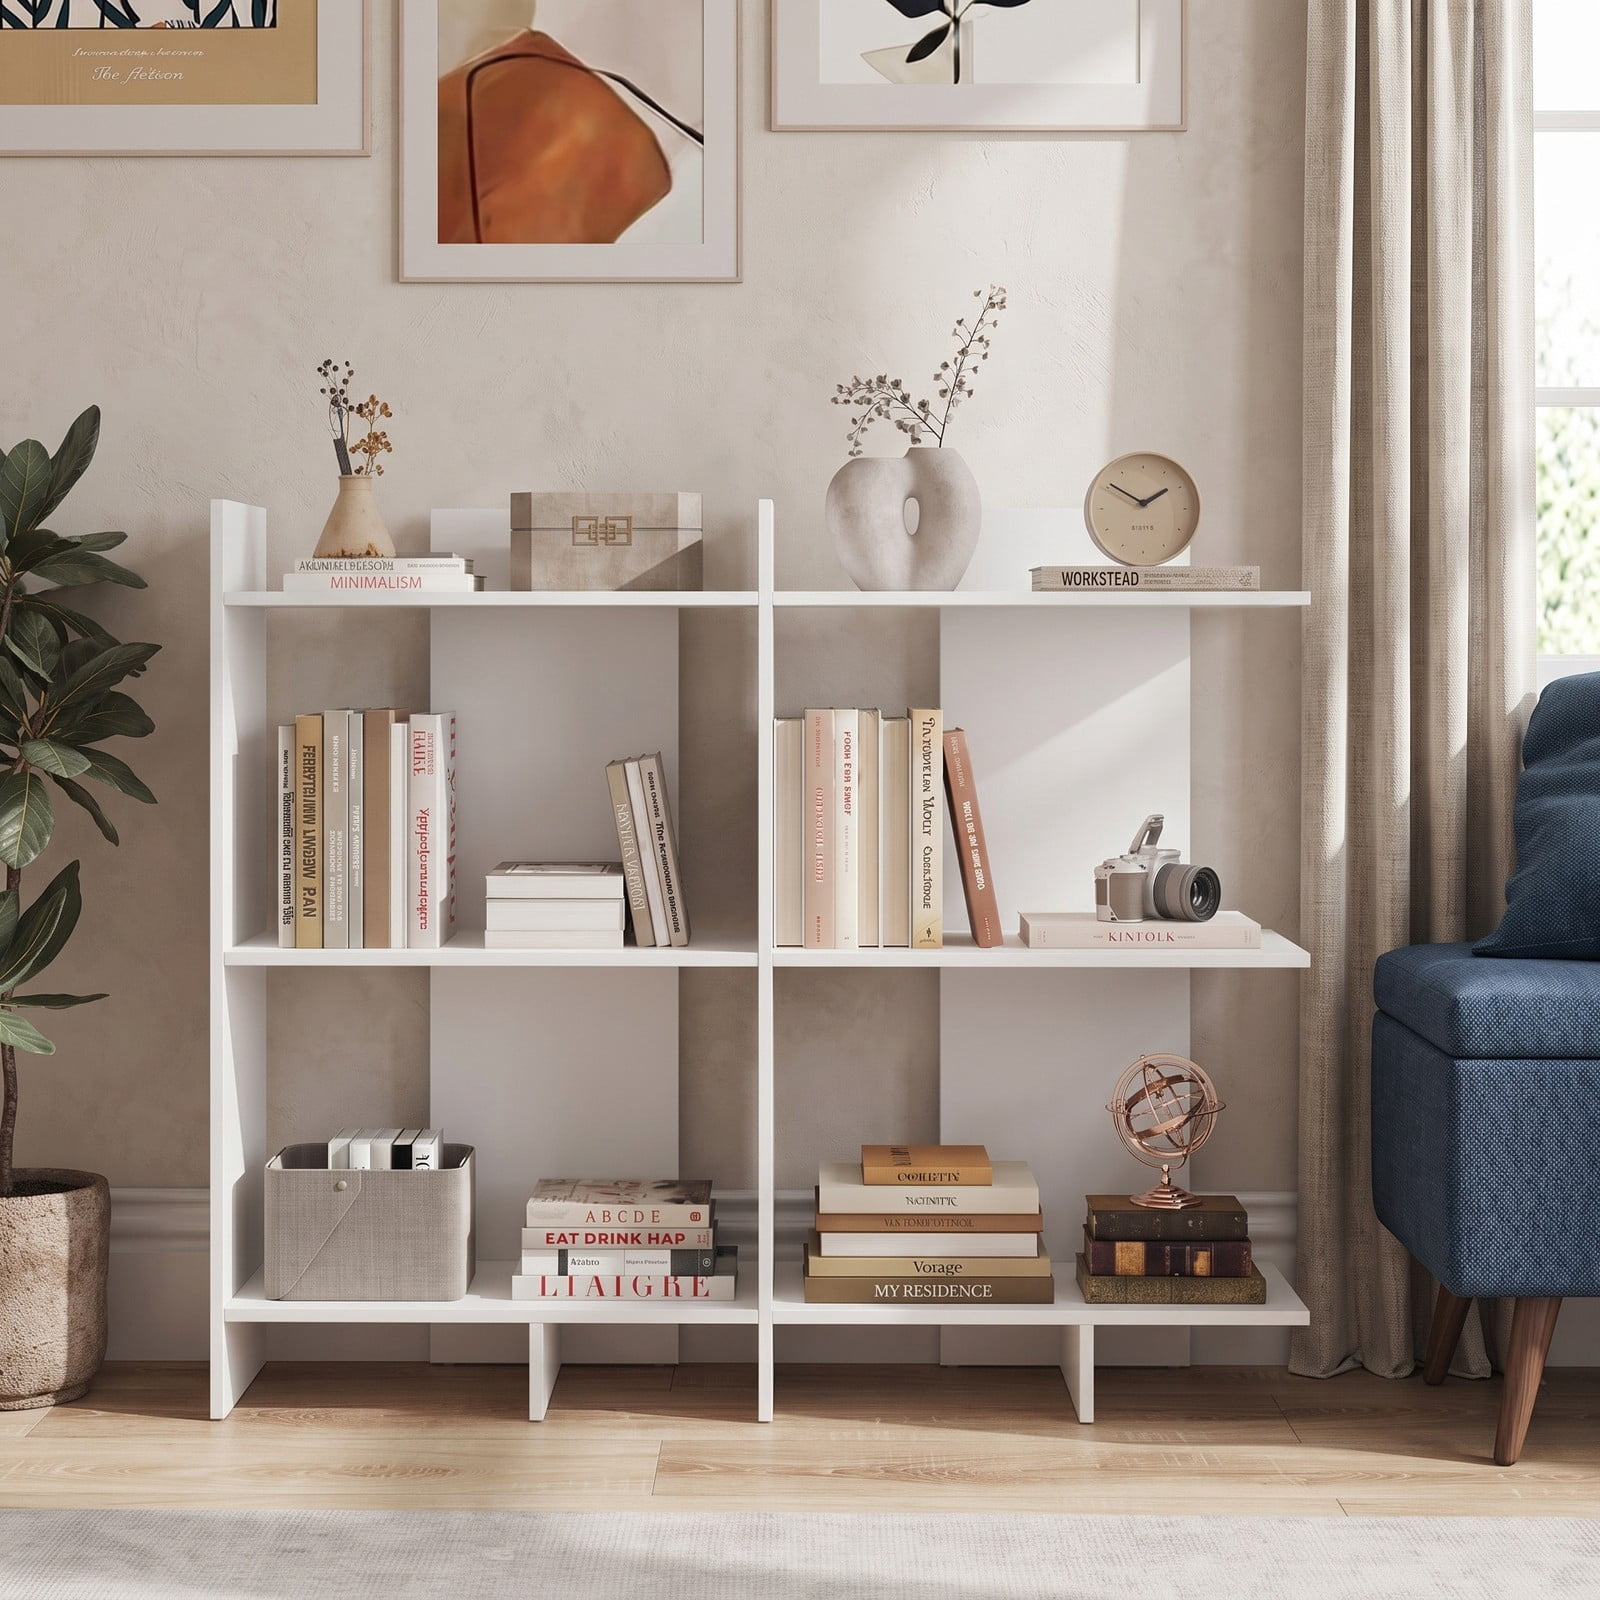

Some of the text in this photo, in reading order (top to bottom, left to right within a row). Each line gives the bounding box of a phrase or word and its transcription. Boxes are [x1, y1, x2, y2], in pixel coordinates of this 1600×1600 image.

[330, 576, 422, 589] MINIMALISM
[1061, 571, 1139, 586] WORKSTEAD
[545, 1232, 580, 1245] EAT
[584, 1232, 642, 1245] DRINK
[647, 1232, 686, 1245] HAP
[913, 1261, 963, 1275] Vorage
[874, 1284, 992, 1298] MY RESIDENCE
